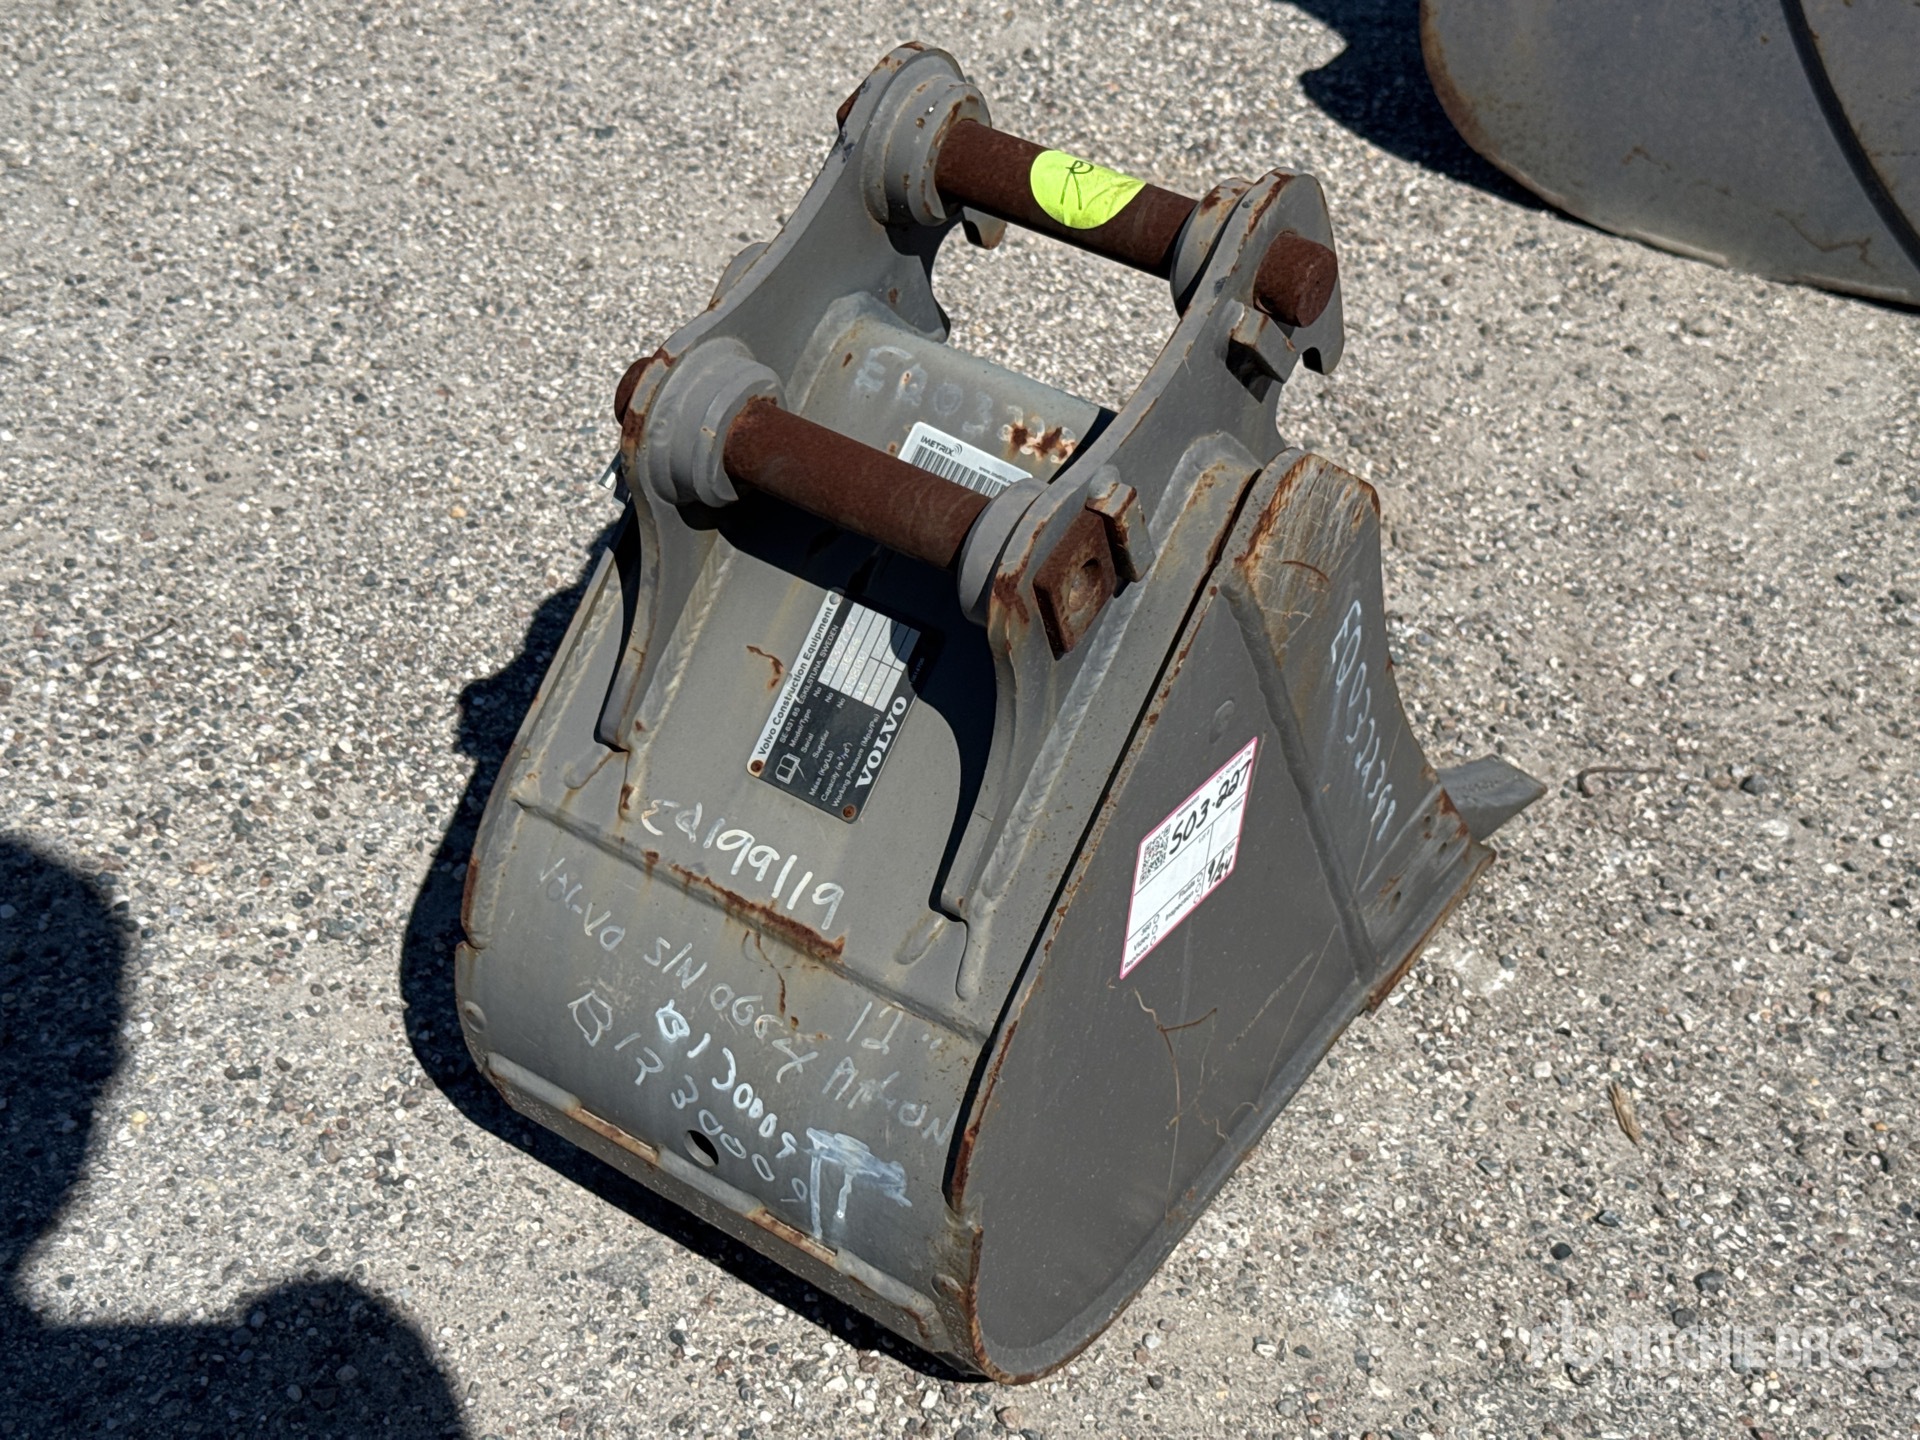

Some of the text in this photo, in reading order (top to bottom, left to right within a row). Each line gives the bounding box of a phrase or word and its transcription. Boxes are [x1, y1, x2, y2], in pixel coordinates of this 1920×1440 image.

[920, 436, 955, 457] IMETRIX
[819, 624, 839, 657] SWEDEN
[757, 606, 835, 756] Volvo Construction Equipment
[800, 732, 814, 753] Serial
[812, 729, 831, 759] Supplier
[854, 696, 908, 789] VOLVO
[808, 776, 822, 796] Mass
[820, 770, 839, 802] Capacity
[832, 778, 851, 809] Working
[845, 747, 864, 779] Pressure
[643, 936, 708, 990] S/N
